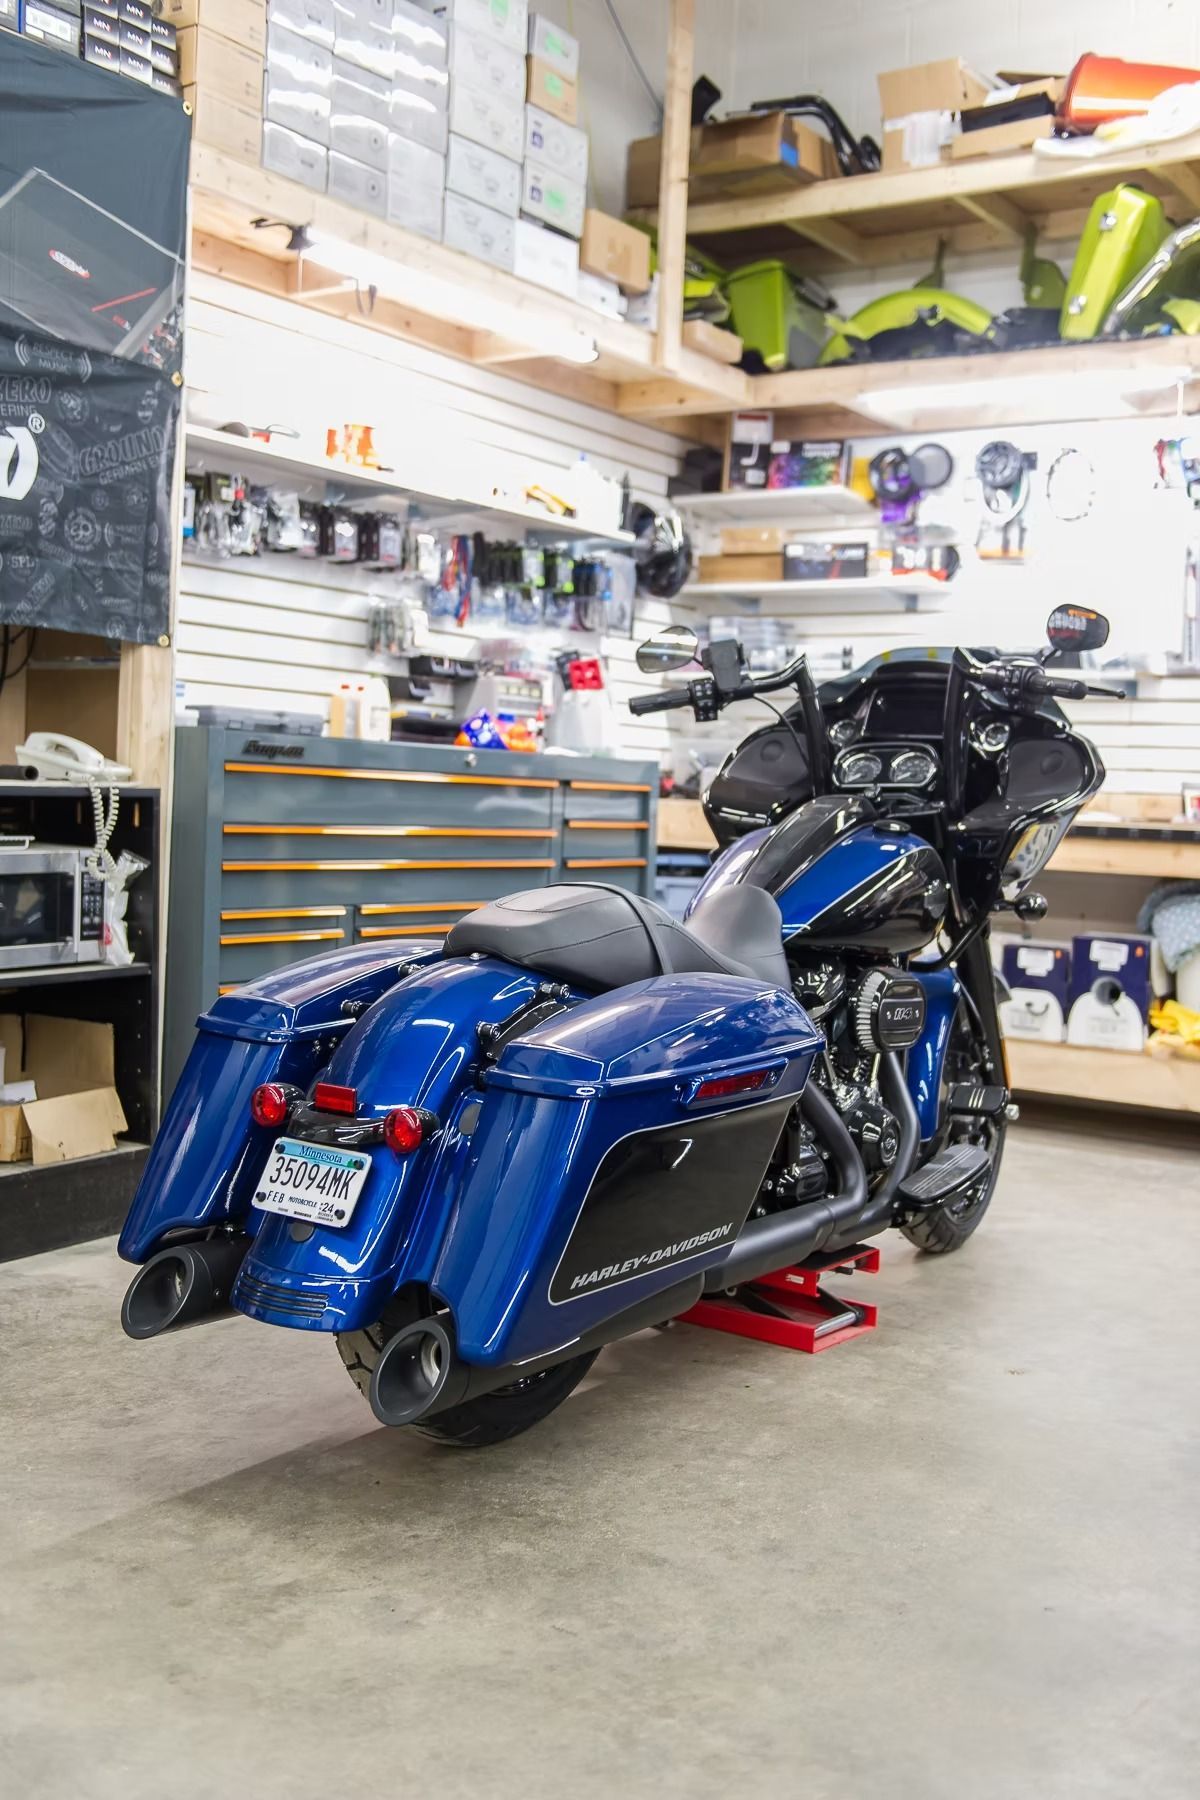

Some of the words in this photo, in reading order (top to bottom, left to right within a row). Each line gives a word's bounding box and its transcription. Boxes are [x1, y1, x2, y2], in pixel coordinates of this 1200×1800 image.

[893, 1007, 913, 1020] 114
[299, 1145, 343, 1164] Minnesota
[269, 1156, 357, 1201] 35094MK
[266, 1190, 285, 1204] FEB
[288, 1195, 318, 1208] MOTORCYCLE
[569, 1222, 735, 1291] HARLEY-DAVIDSON
